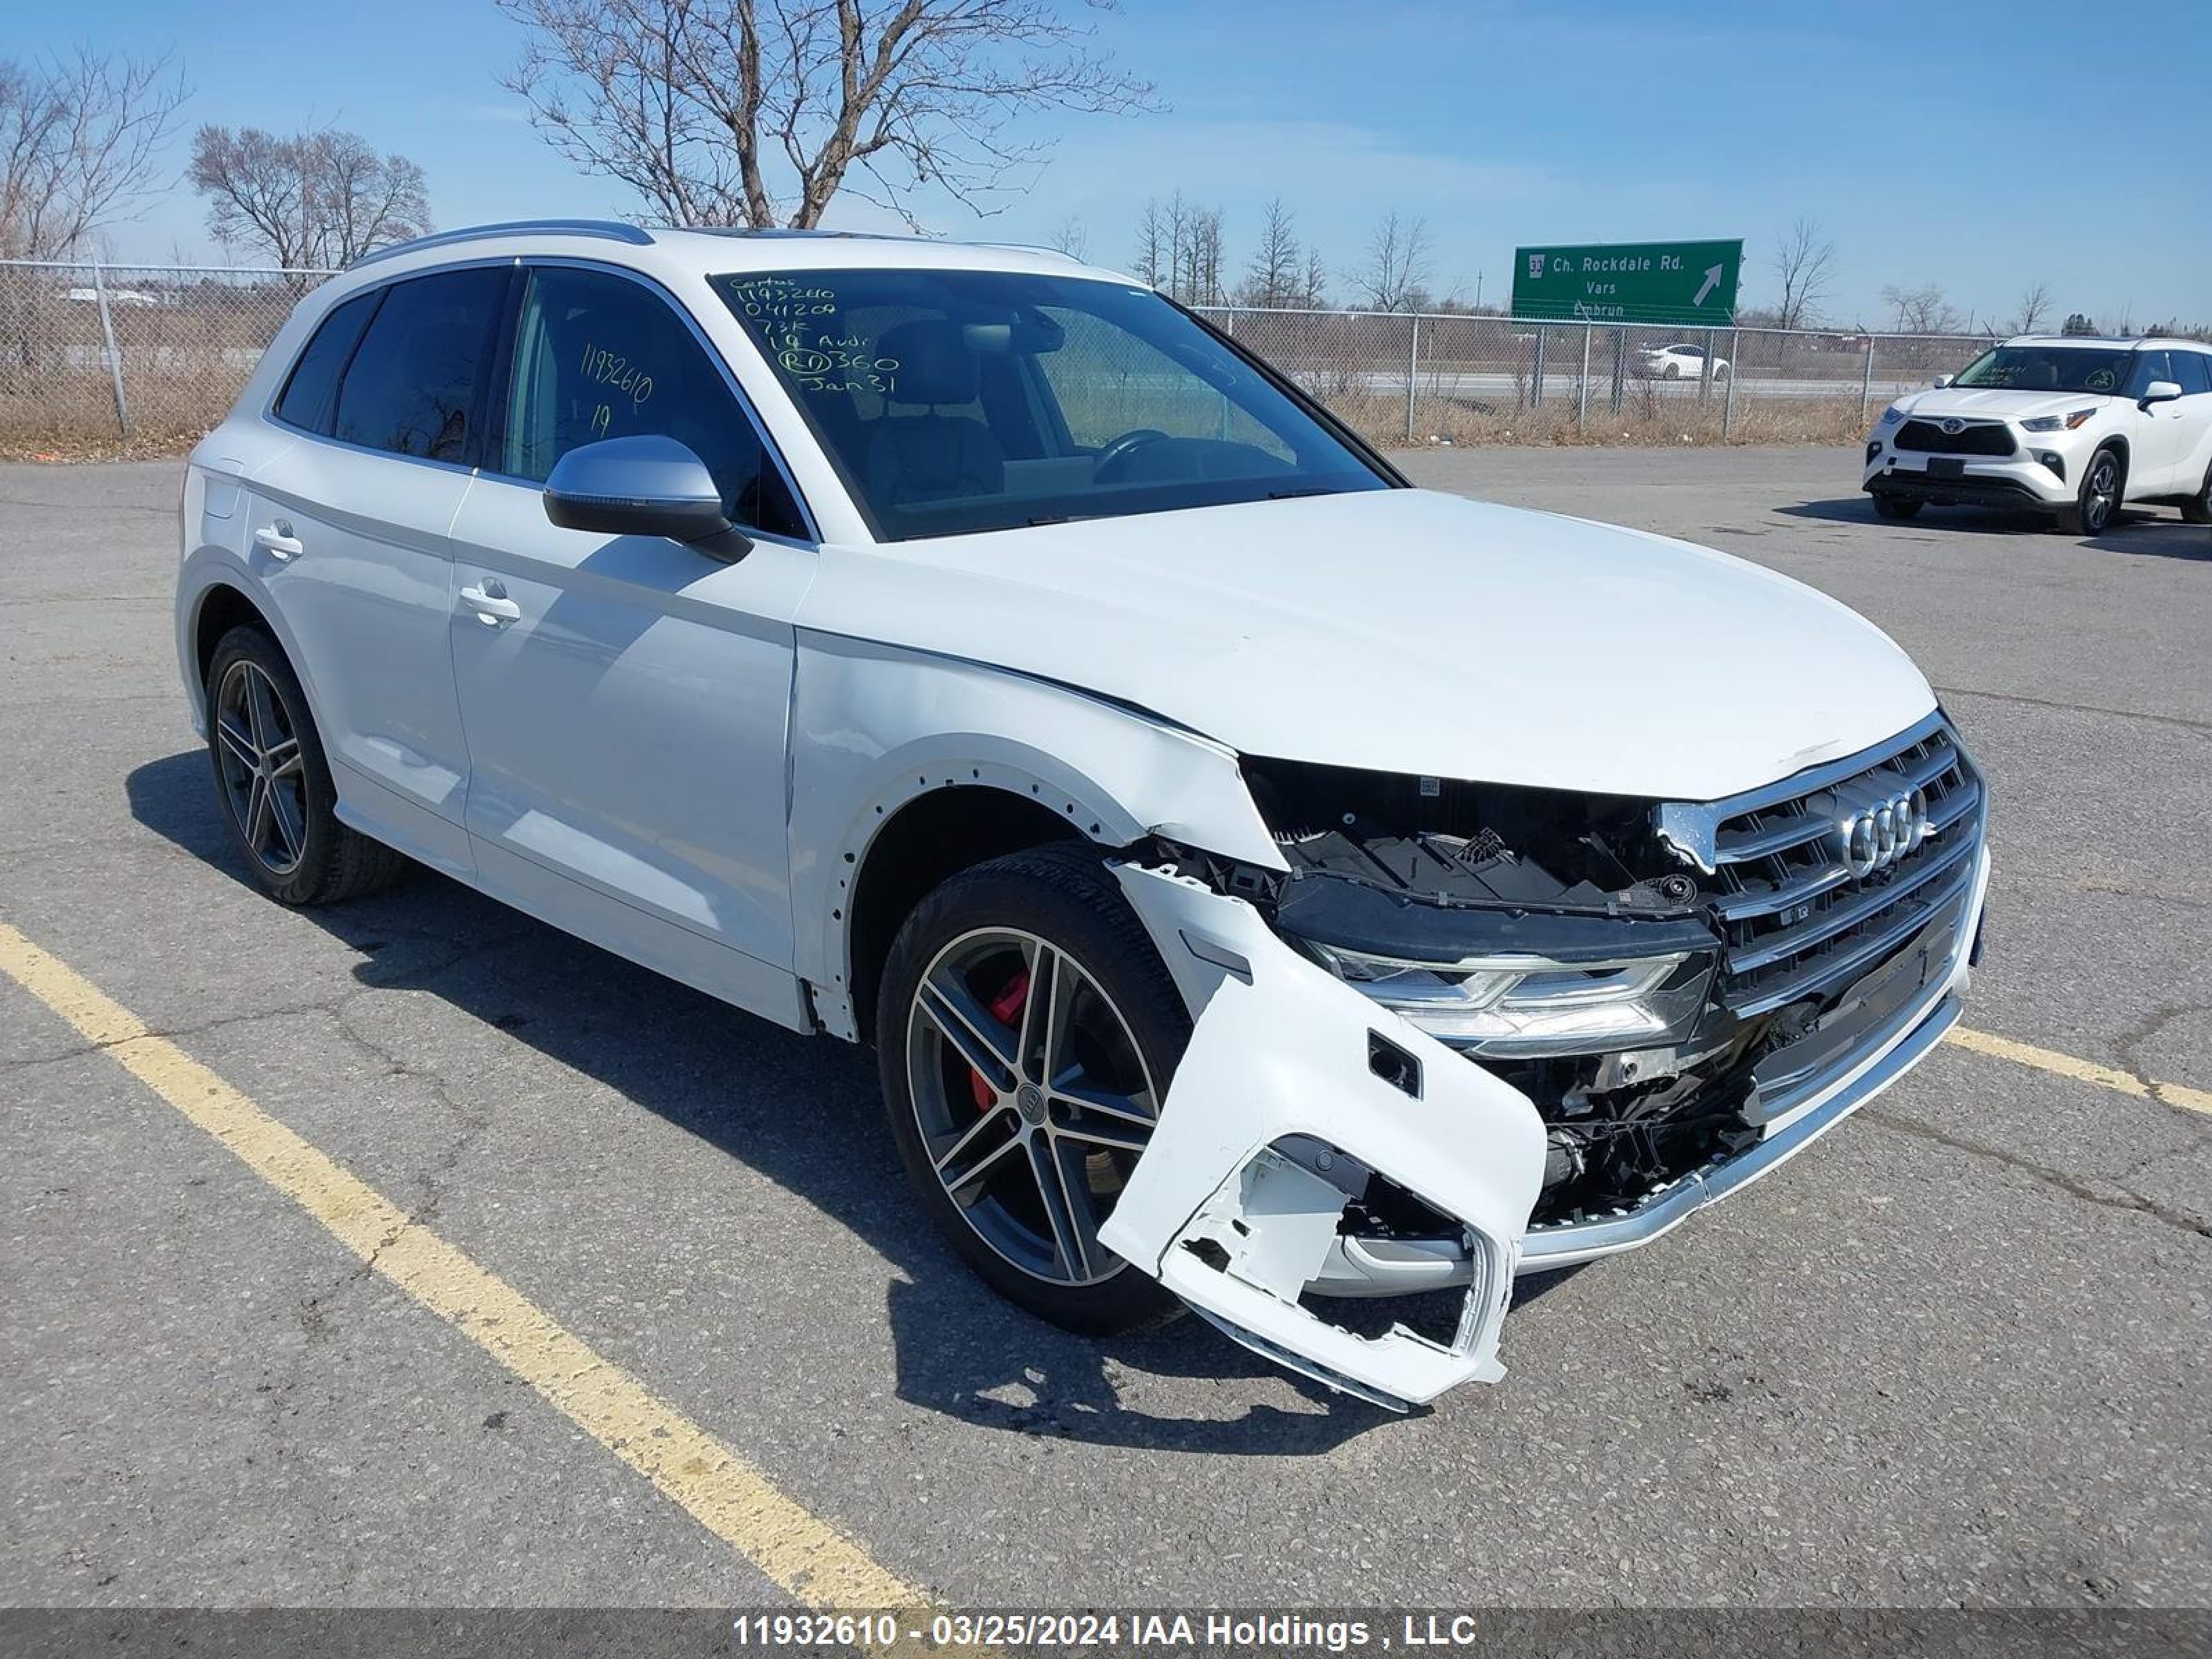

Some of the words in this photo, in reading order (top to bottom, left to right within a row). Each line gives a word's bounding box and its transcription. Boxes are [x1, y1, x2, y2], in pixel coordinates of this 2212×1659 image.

[1553, 257, 1574, 272] Ch.
[1582, 256, 1651, 272] Rockdale
[1660, 255, 1684, 270] Rd.
[1586, 281, 1615, 294] Vars
[770, 334, 800, 350] 19
[819, 334, 870, 348] Audi
[580, 342, 653, 404] 11932610
[798, 377, 863, 391] Jan
[867, 375, 896, 393] 31
[591, 404, 610, 438] 19
